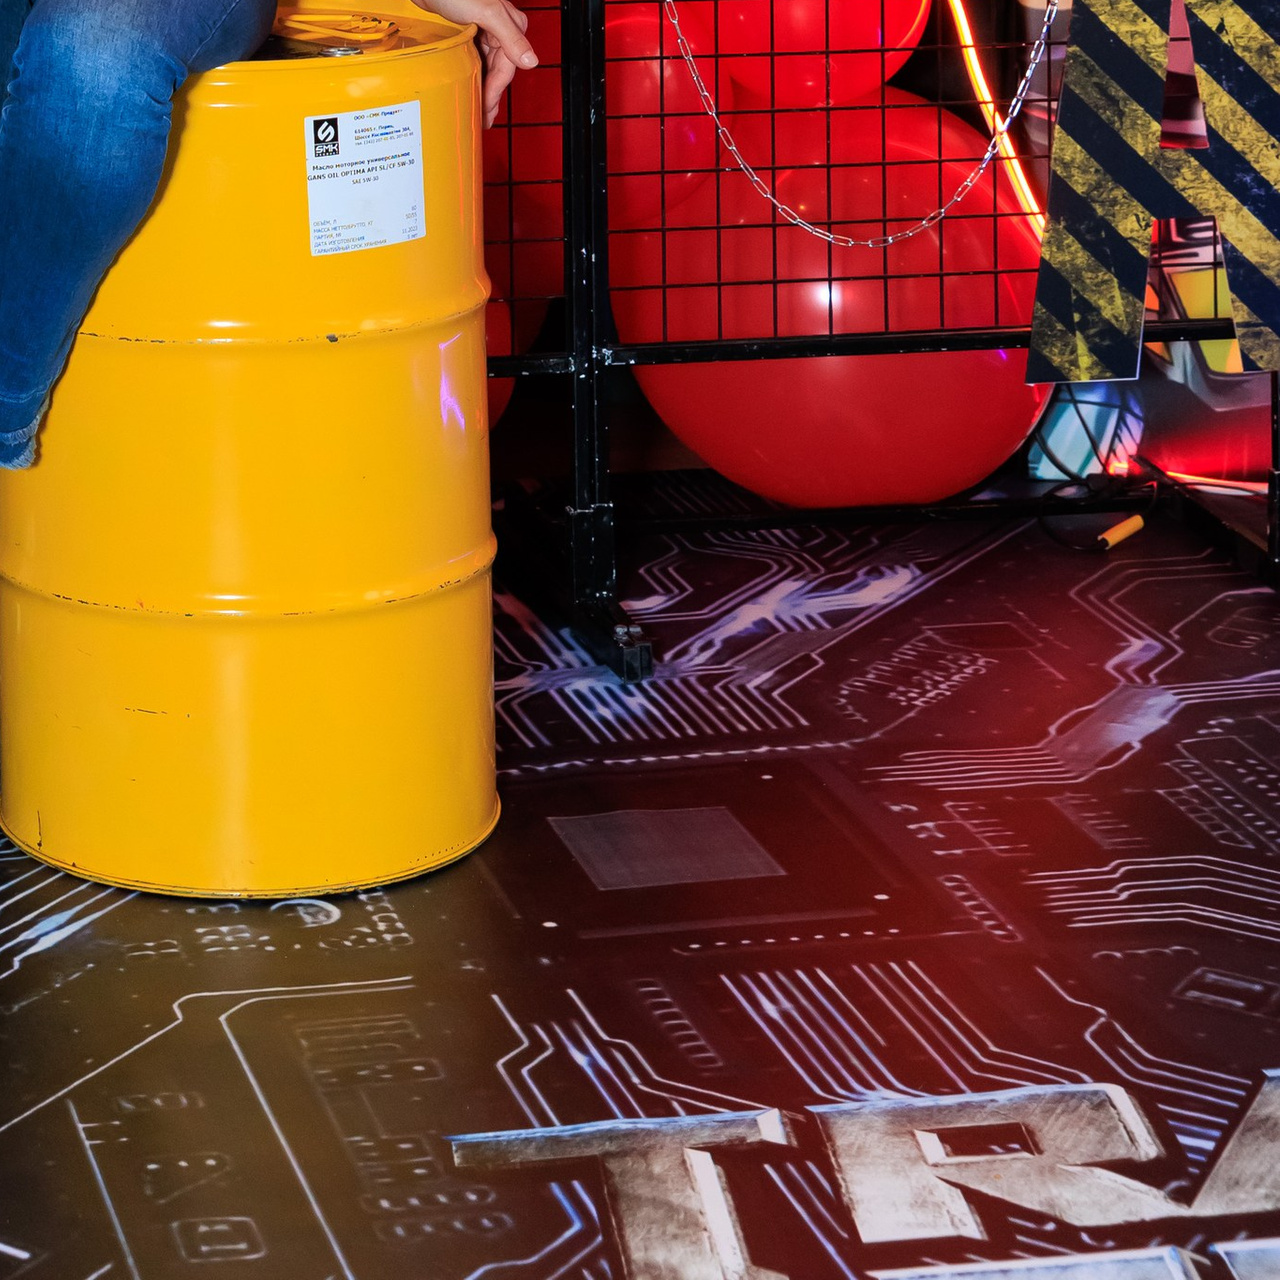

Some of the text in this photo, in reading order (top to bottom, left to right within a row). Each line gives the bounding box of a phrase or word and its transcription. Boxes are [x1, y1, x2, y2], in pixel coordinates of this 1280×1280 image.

[316, 144, 338, 154] SMK
[335, 160, 365, 168] моторное
[367, 152, 410, 165] универсальное
[341, 168, 366, 177] OPTIMA
[379, 163, 396, 171] SL/CF
[397, 159, 415, 167] 5W-30
[444, 1068, 1280, 1280] TR
